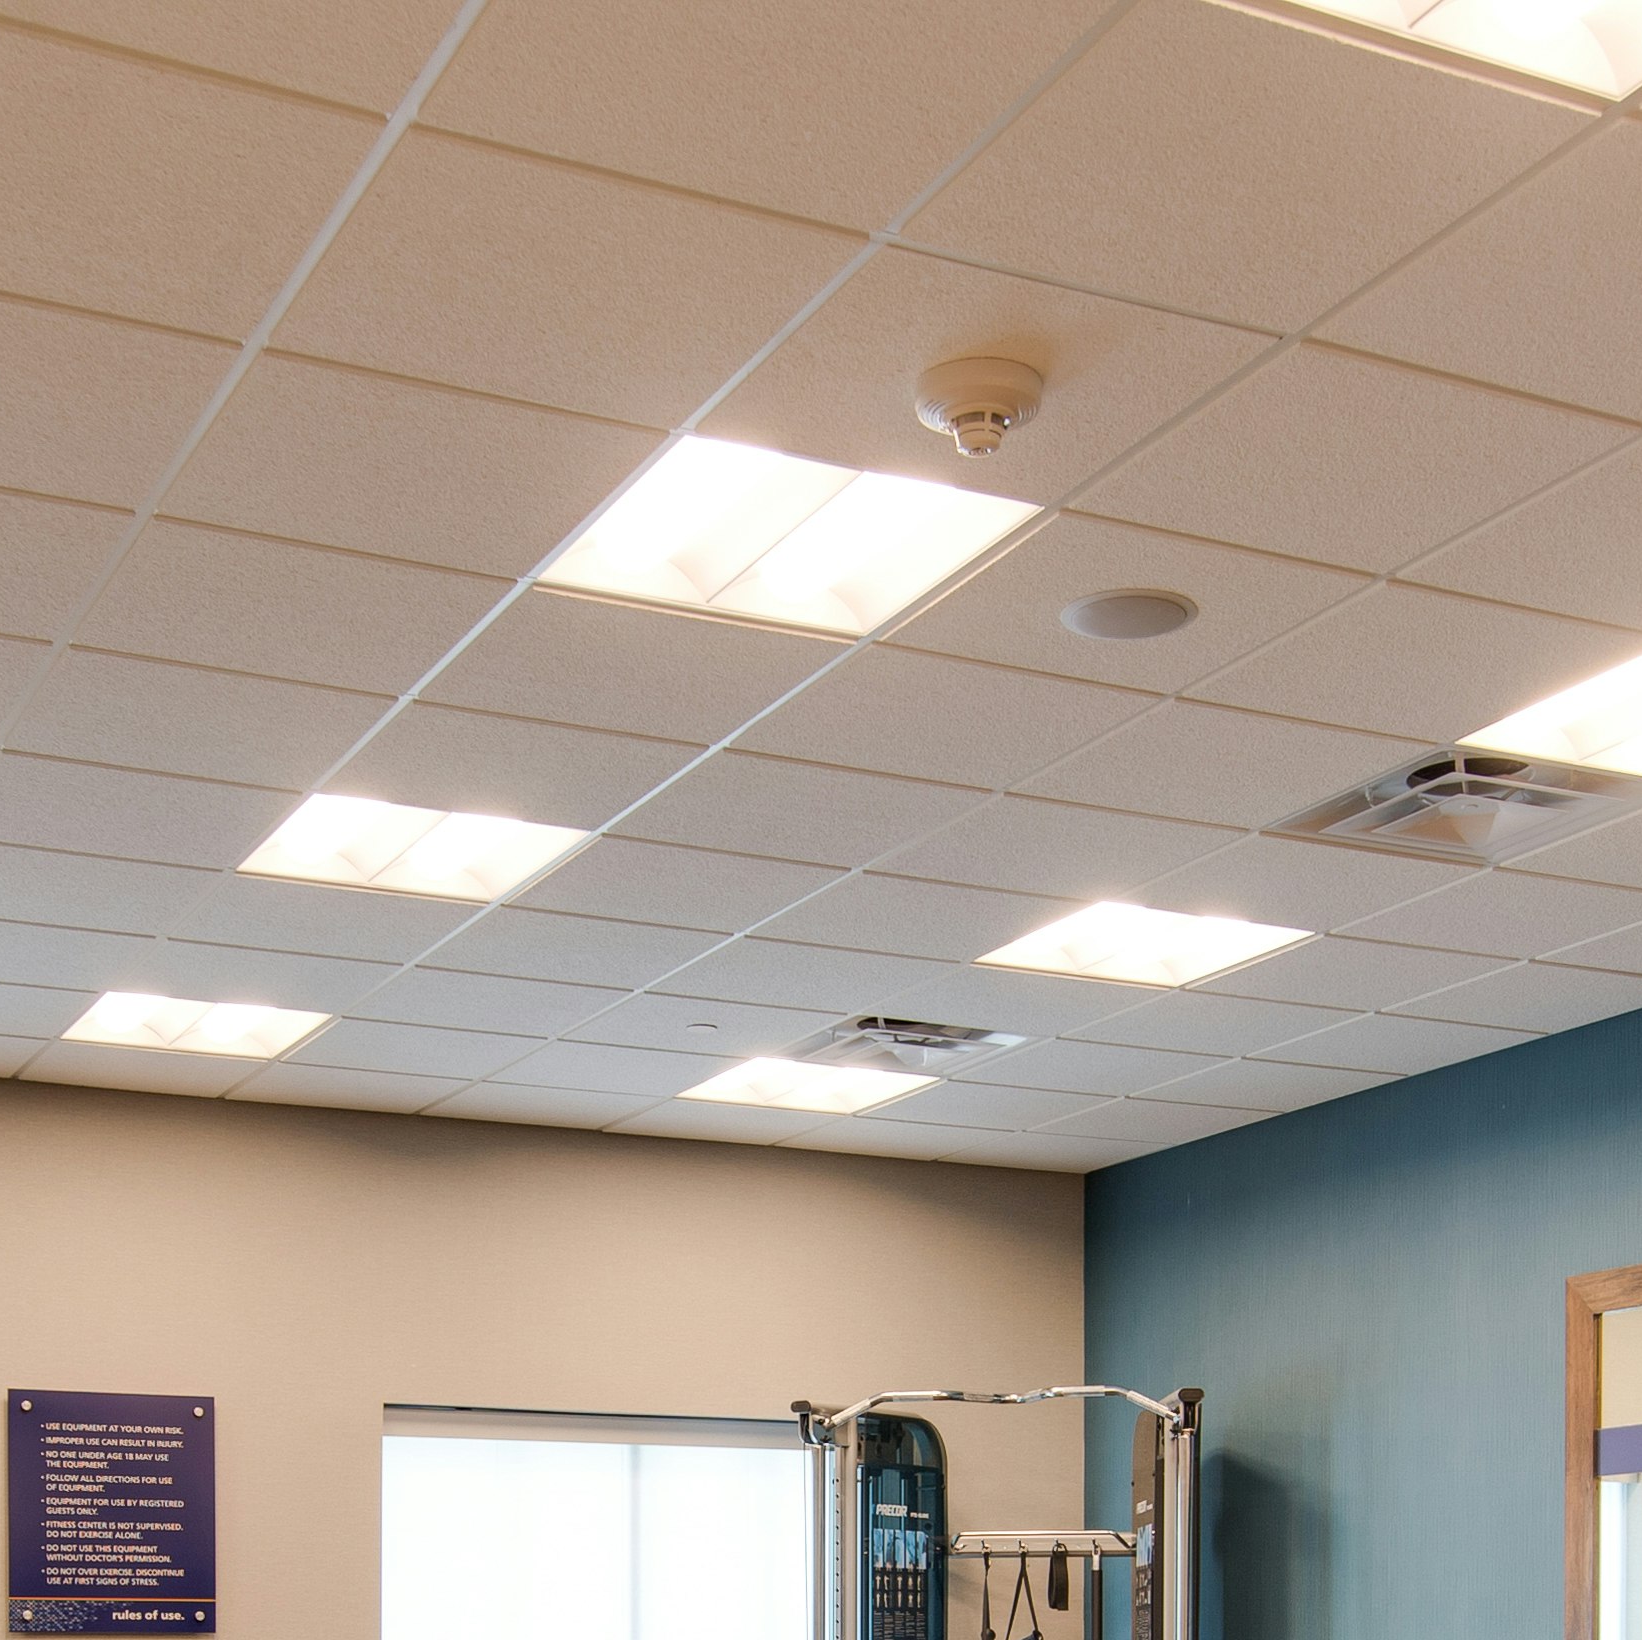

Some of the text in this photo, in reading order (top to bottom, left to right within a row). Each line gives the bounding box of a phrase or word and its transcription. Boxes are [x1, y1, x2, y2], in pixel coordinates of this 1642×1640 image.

[63, 1423, 107, 1431] EQUIPMENT
[120, 1425, 142, 1433] YOUR
[157, 1440, 183, 1448] INJURY.
[63, 1461, 109, 1469] EQUIPMENT.
[96, 1475, 140, 1483] DIRECTIONS
[46, 1497, 91, 1505] EQUIPMENT
[113, 1545, 157, 1553] EQUIPMENT
[85, 1554, 123, 1562] DOCTOR'S
[113, 1610, 185, 1620] rules of use.
